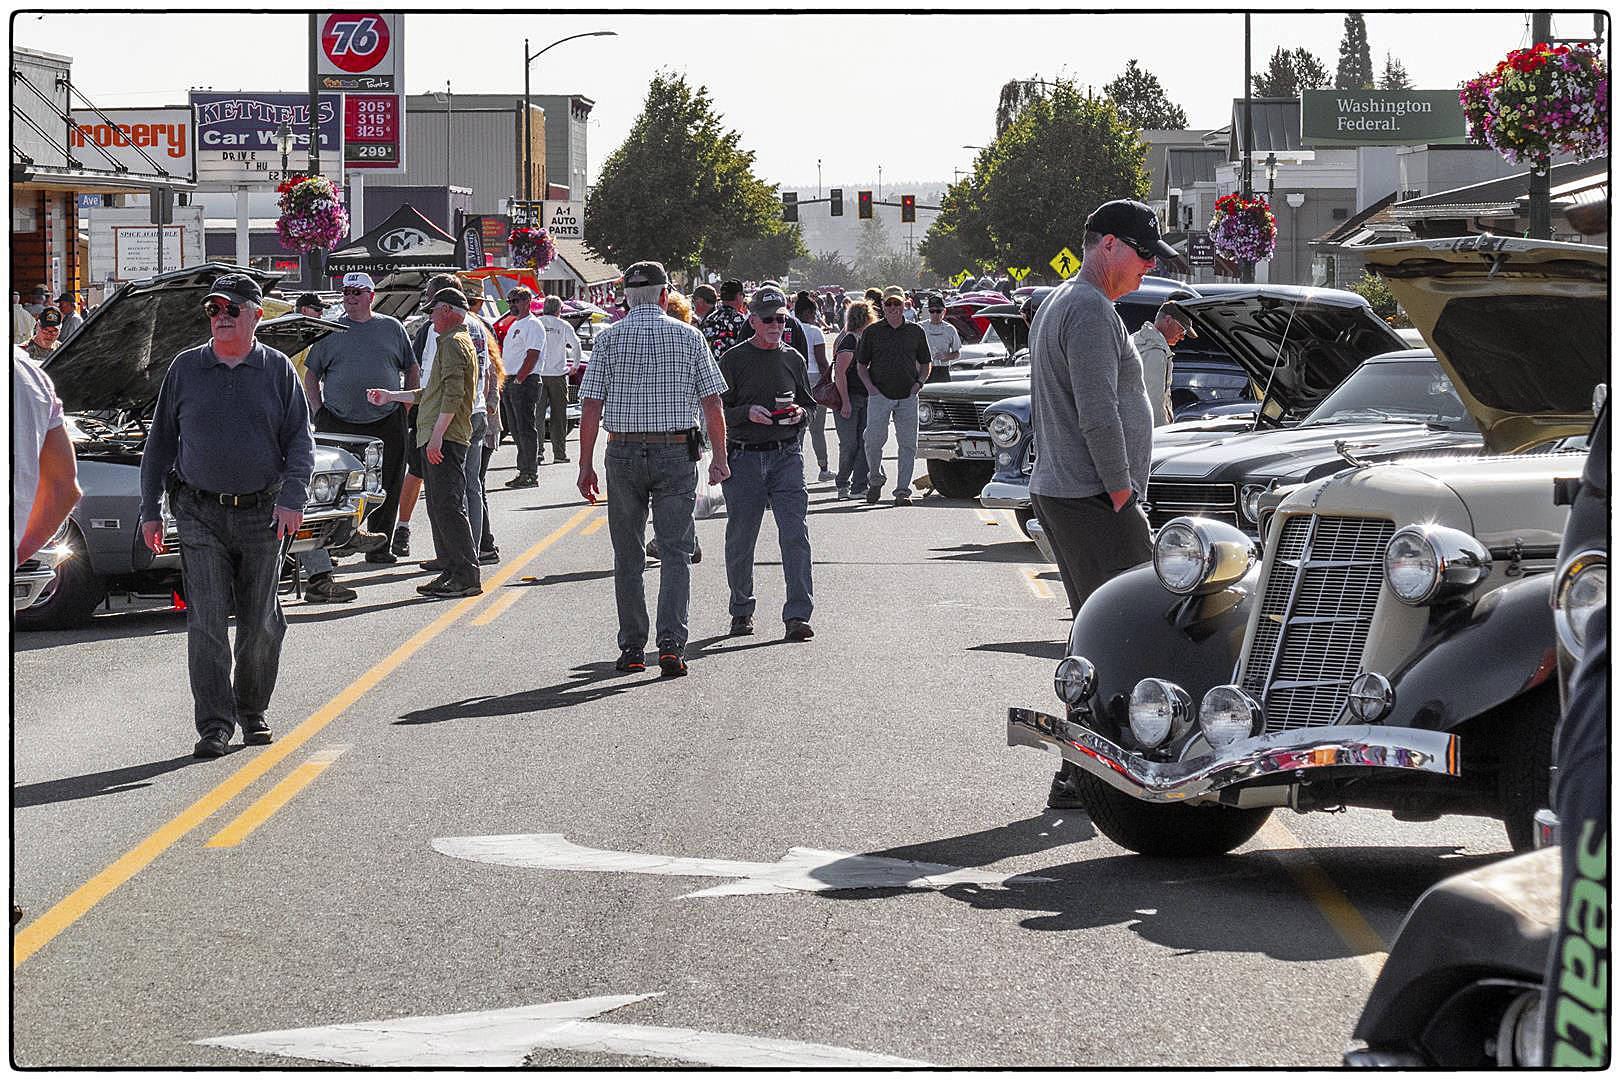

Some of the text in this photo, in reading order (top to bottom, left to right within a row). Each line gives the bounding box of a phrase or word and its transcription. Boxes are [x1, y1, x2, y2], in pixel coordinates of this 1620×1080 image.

[330, 17, 380, 56] 76
[358, 101, 385, 112] 305
[1336, 98, 1432, 116] Washington
[1336, 116, 1401, 131] Federal.
[70, 119, 187, 158] rocery
[203, 130, 329, 145] Car Wsh
[222, 152, 256, 160] DRIVE
[359, 146, 387, 157] 299
[82, 194, 99, 206] Ave
[551, 217, 577, 225] AUTO
[549, 226, 579, 235] PARTS
